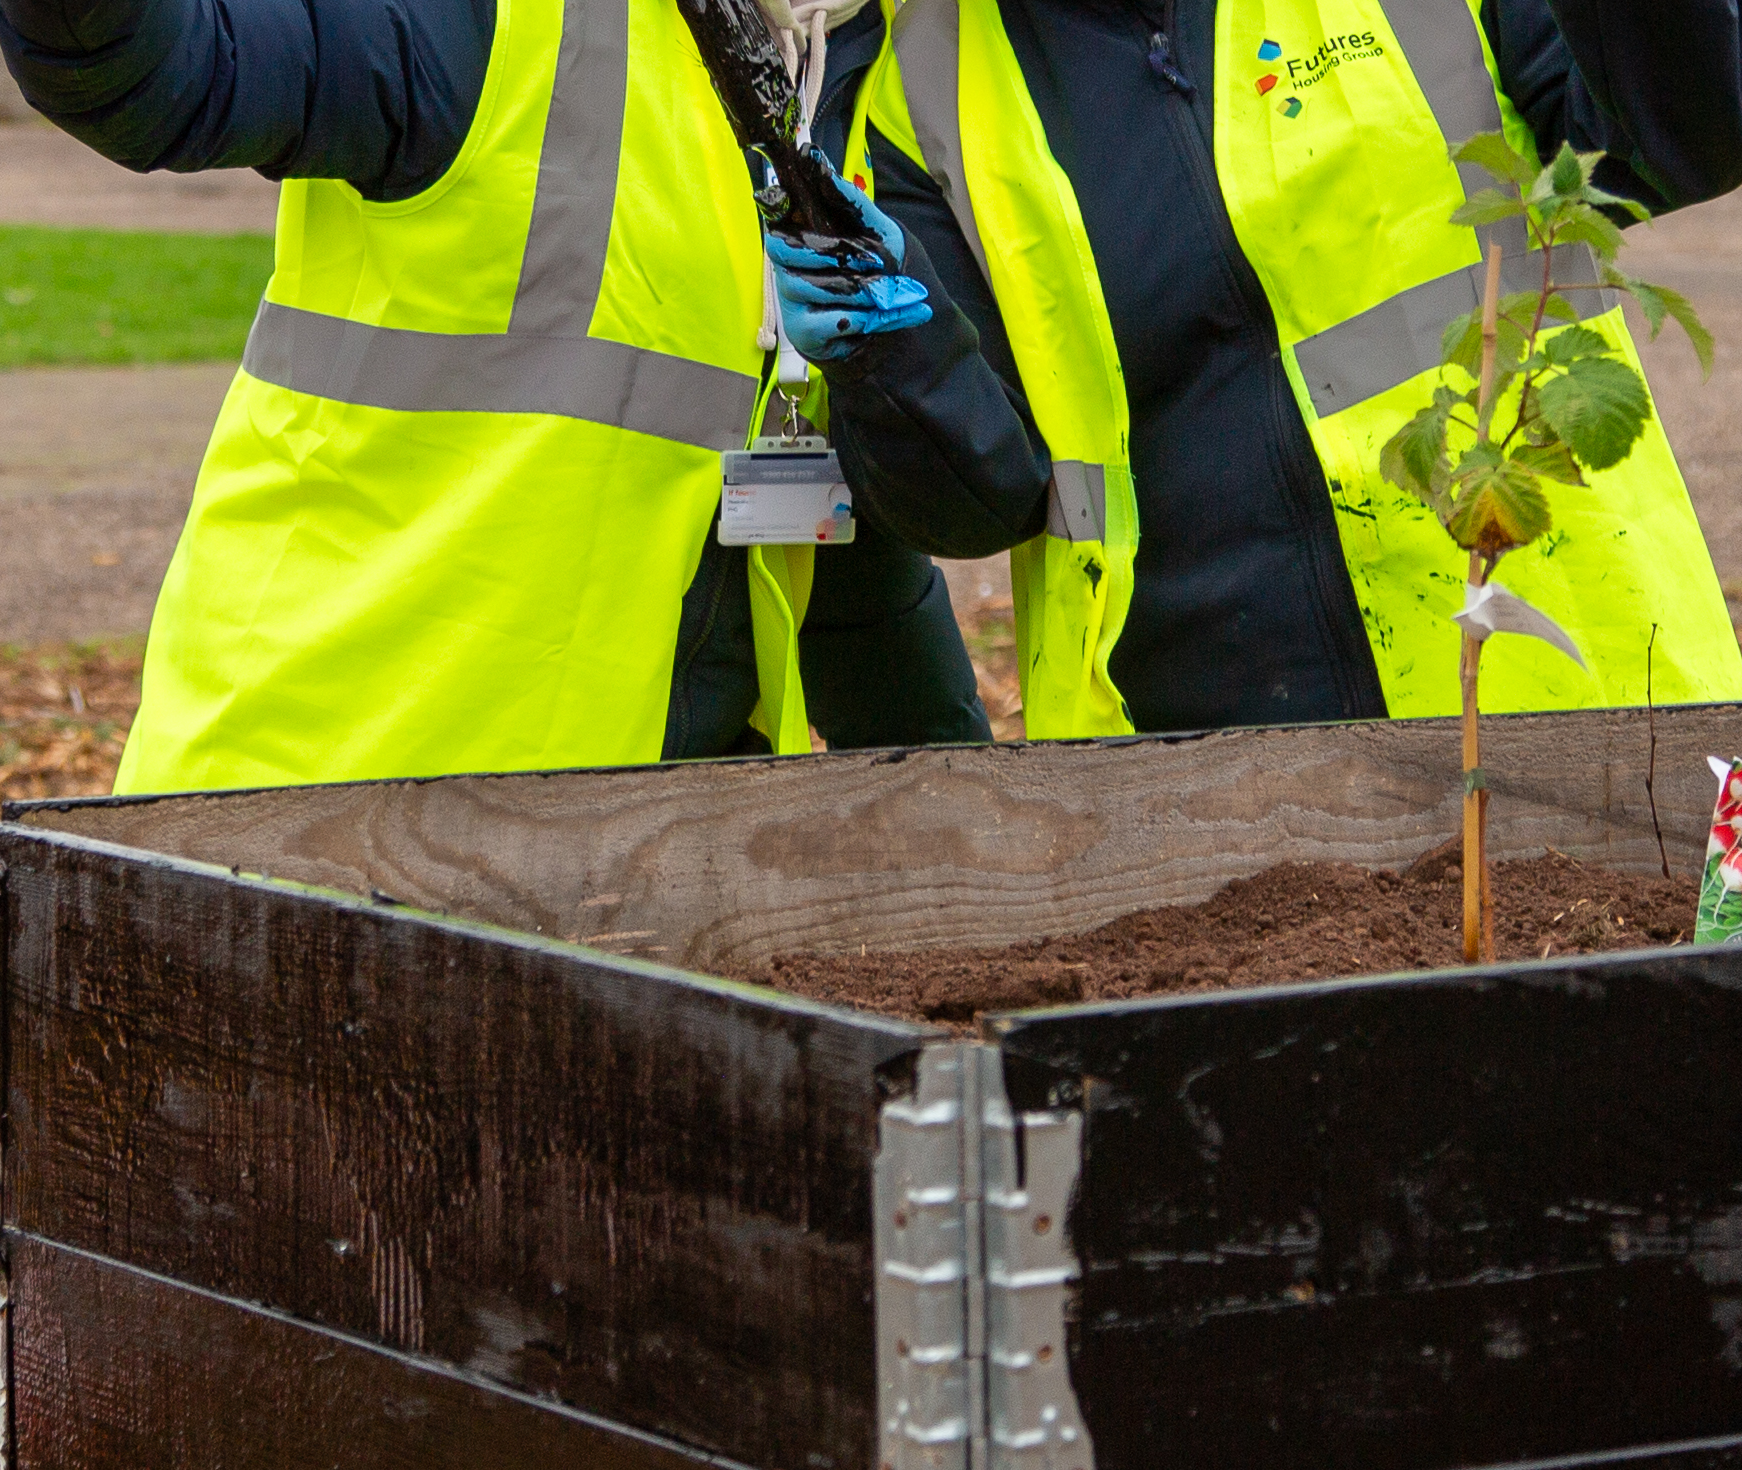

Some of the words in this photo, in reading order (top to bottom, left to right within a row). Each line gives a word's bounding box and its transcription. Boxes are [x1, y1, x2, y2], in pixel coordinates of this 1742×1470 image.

[1286, 31, 1375, 78] Futures
[1292, 55, 1340, 91] Housing
[1342, 46, 1384, 62] Group
